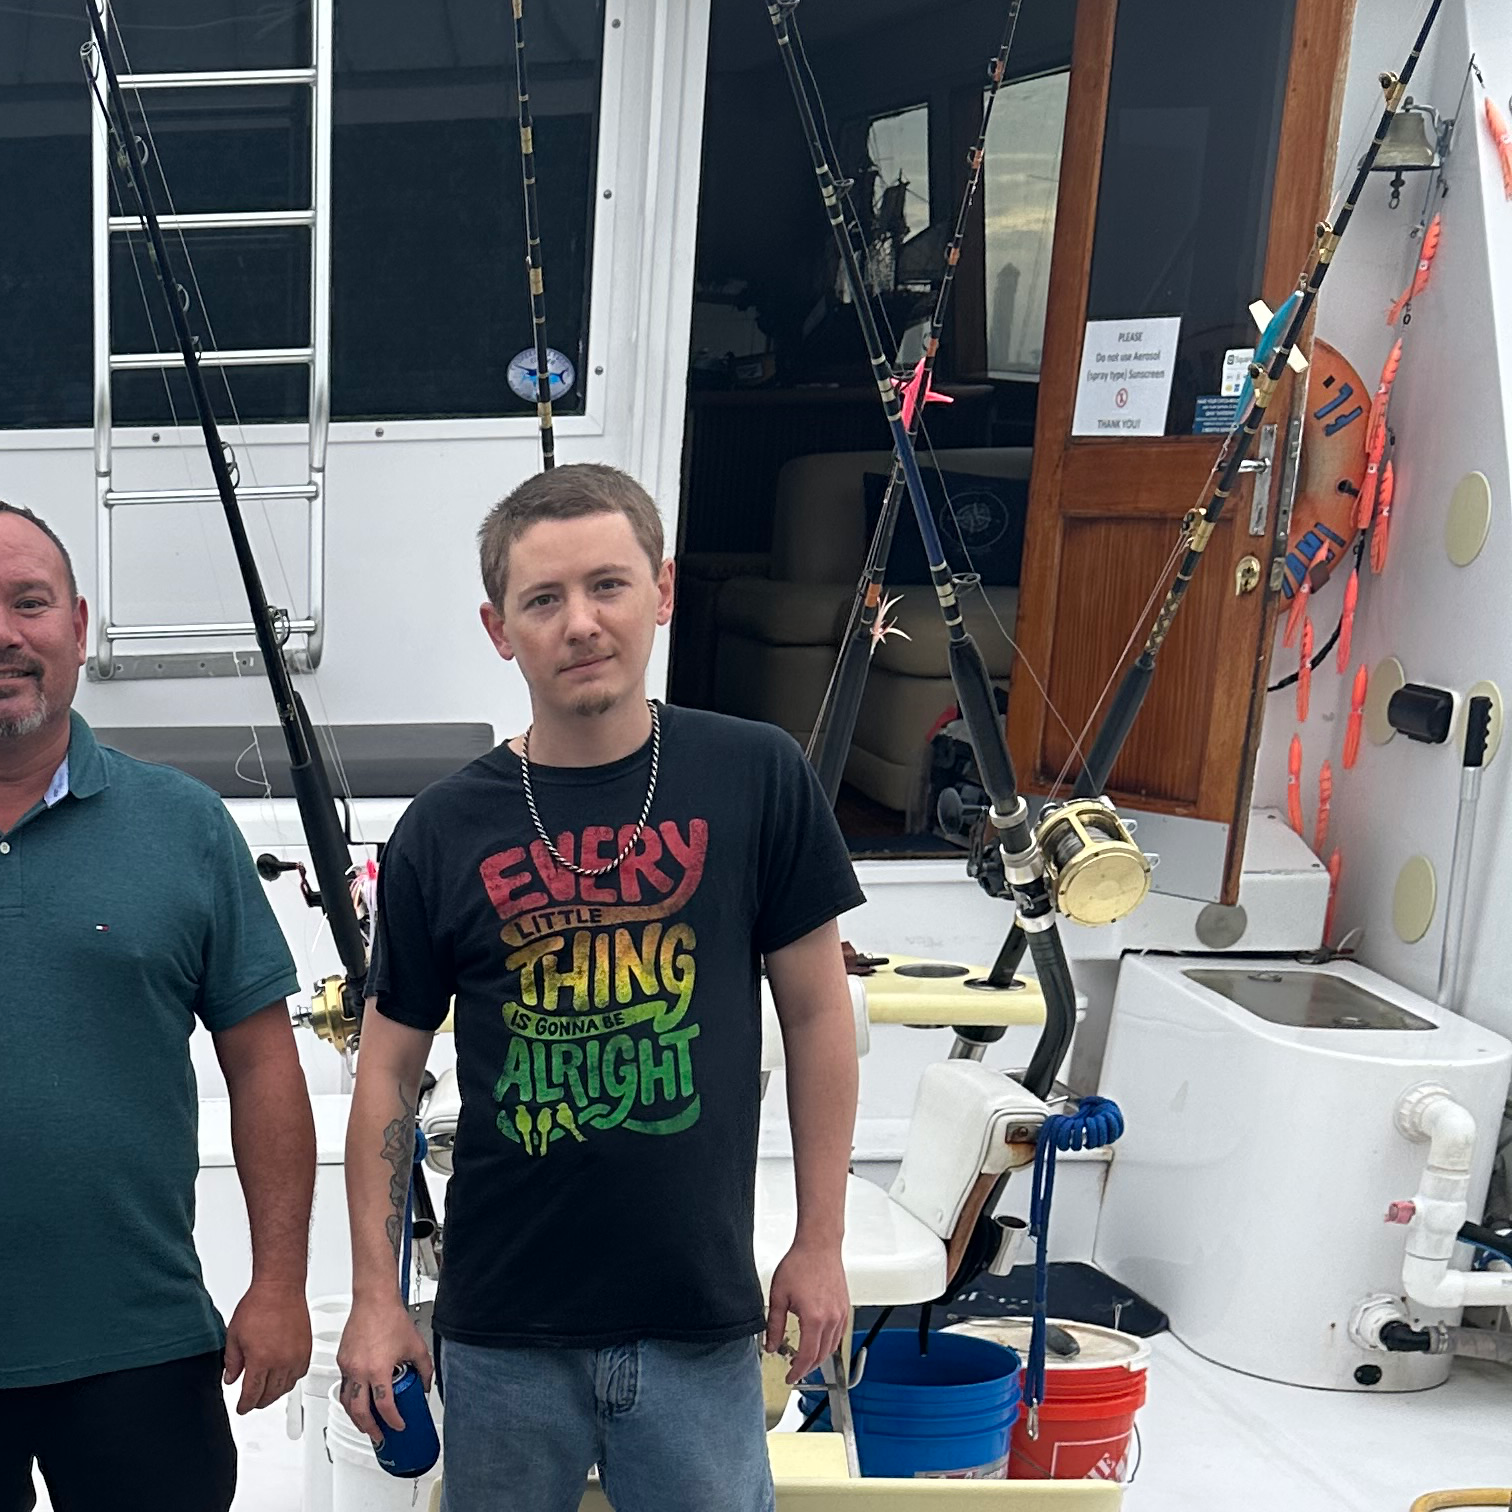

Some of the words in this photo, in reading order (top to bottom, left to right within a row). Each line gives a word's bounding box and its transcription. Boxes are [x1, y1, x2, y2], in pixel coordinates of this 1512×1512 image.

[1118, 332, 1143, 342] PLEASE
[1096, 353, 1106, 362] Do
[1107, 353, 1119, 361] not
[1120, 353, 1132, 361] use
[1133, 350, 1160, 361] Aerosol
[1087, 369, 1109, 382] (spray
[1109, 368, 1128, 382] type)
[1128, 369, 1165, 379] Sunscreen
[1098, 419, 1121, 429] THANK
[479, 818, 708, 920] EVERY
[514, 908, 602, 939] LITTLE
[505, 923, 696, 1012] THING
[510, 1011, 532, 1030] IS
[535, 1014, 595, 1036] GONNA
[602, 1012, 626, 1029] BE
[492, 1023, 701, 1107] ALRIGHT
